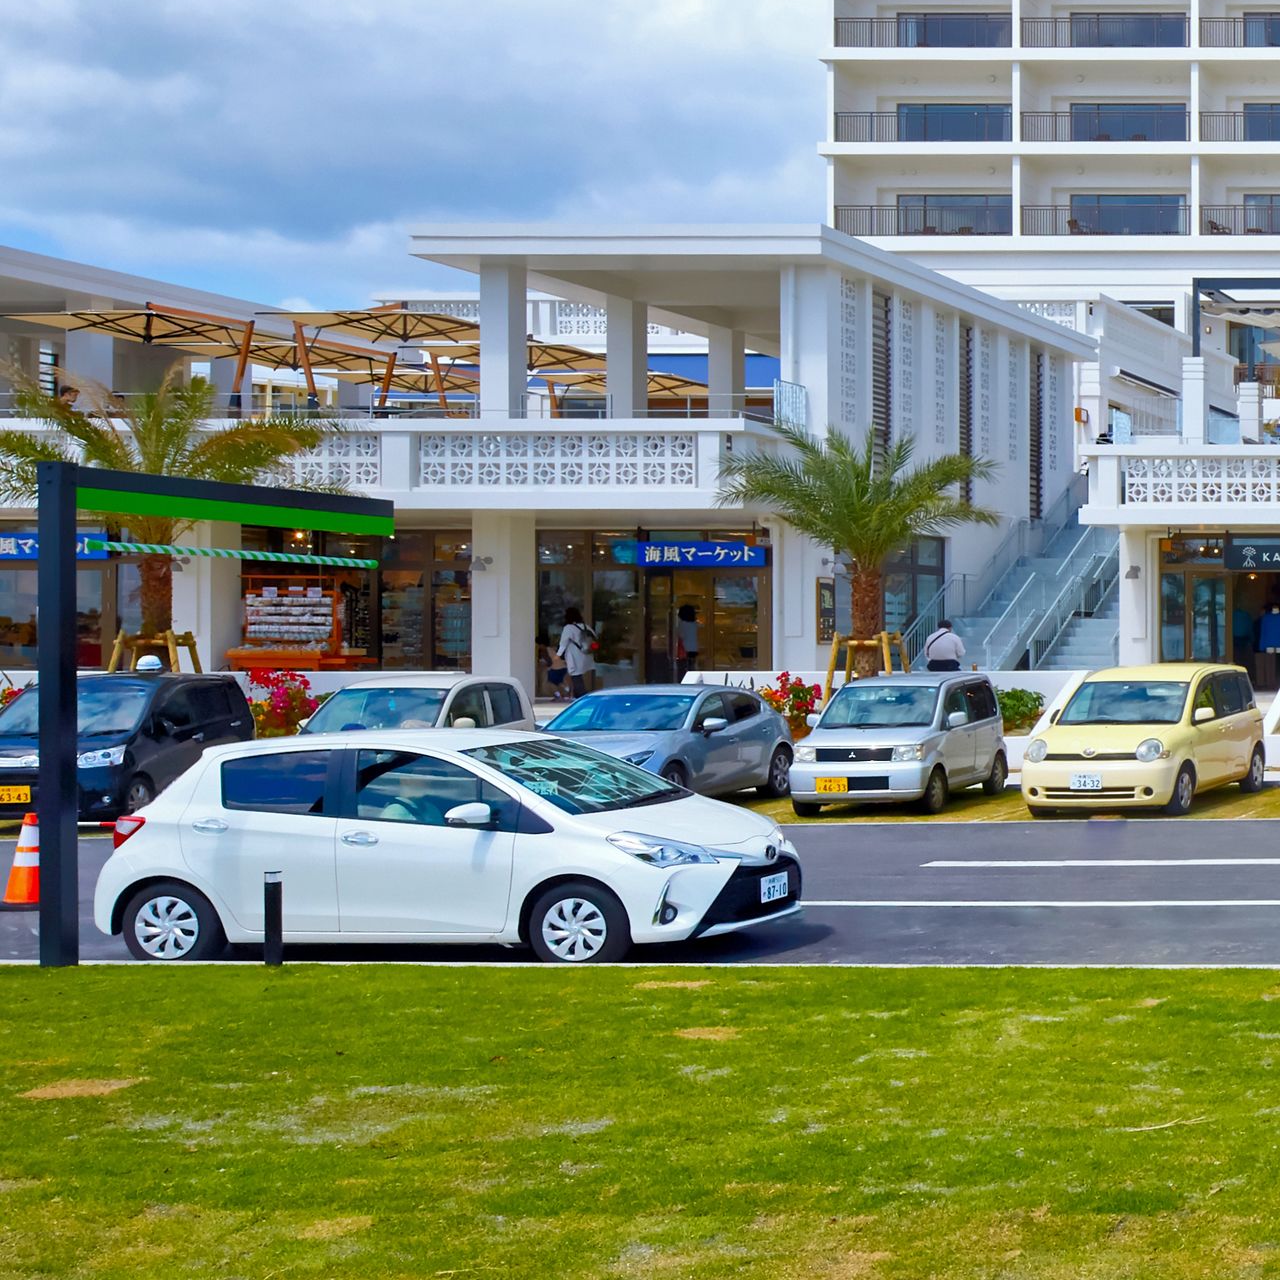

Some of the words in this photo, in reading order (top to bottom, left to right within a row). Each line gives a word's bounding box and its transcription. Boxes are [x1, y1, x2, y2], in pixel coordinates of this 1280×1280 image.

[645, 545, 755, 562] 海風マーケット
